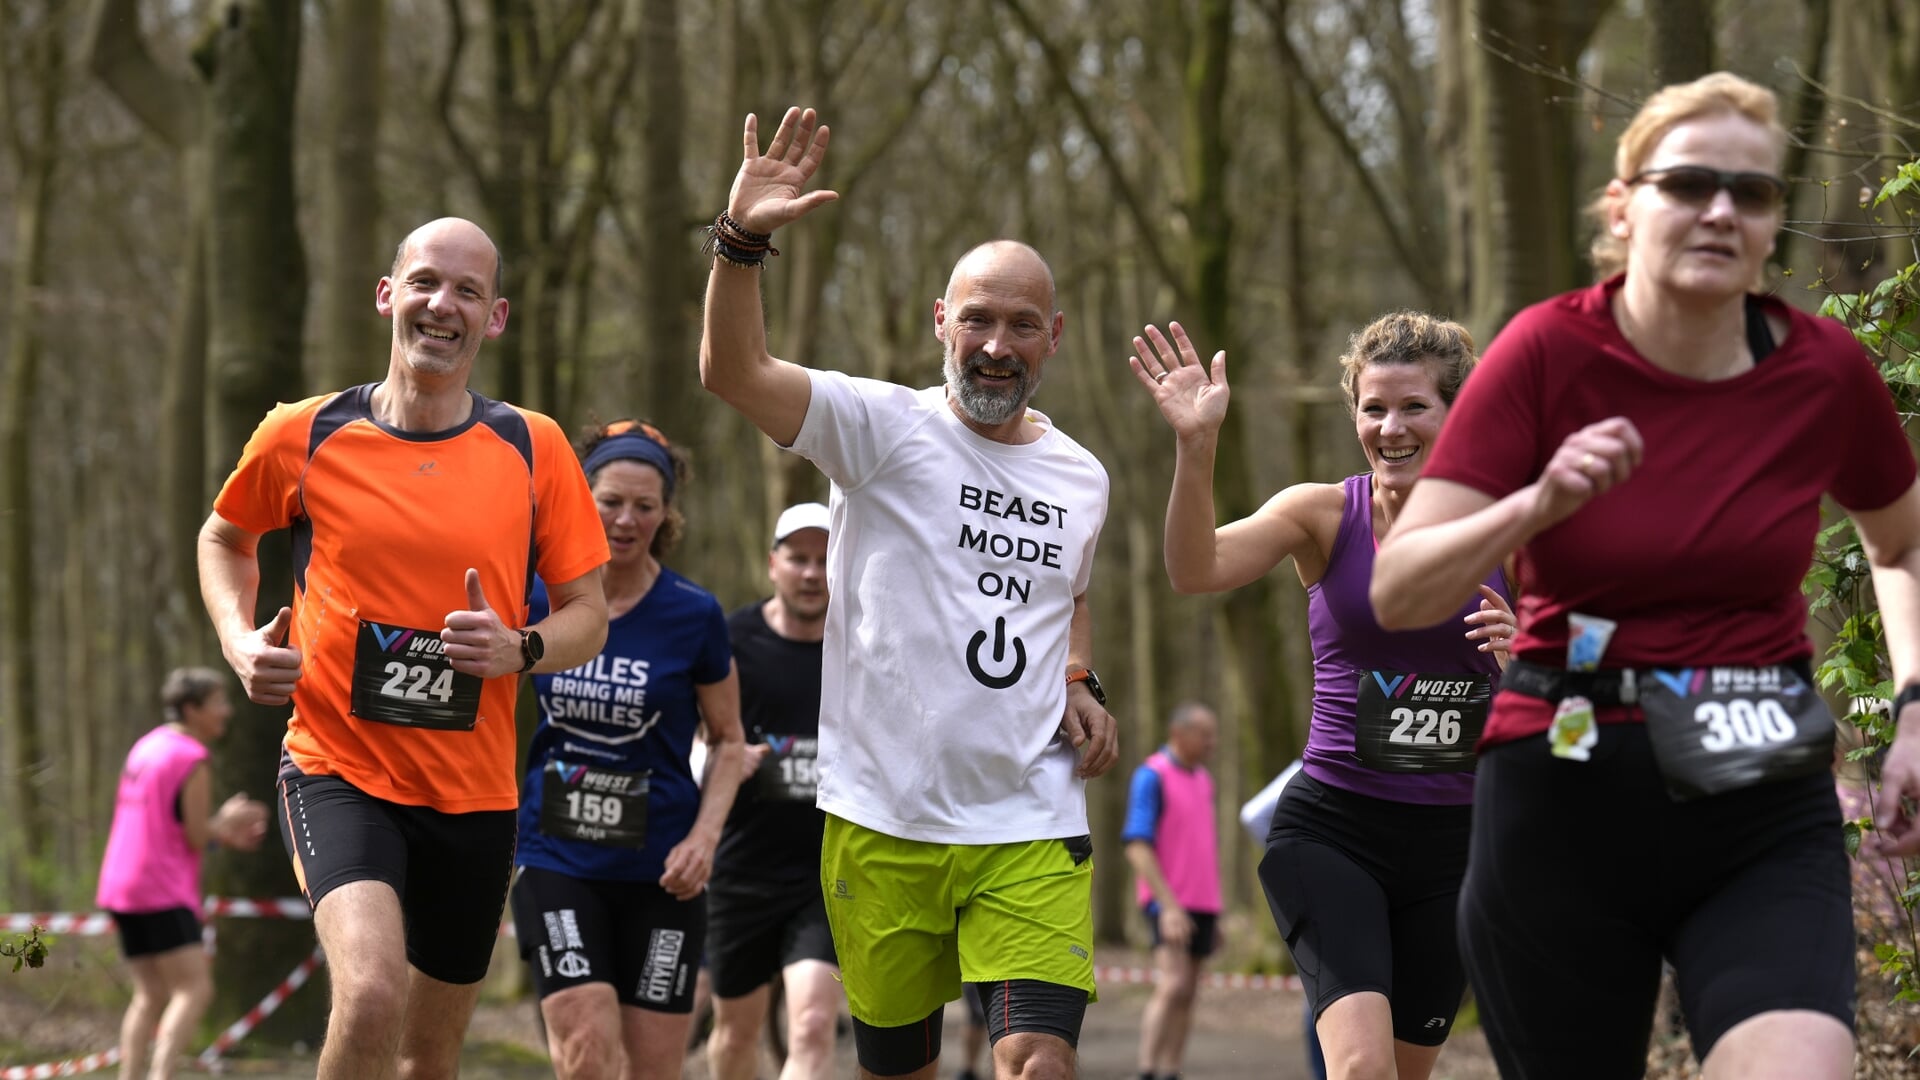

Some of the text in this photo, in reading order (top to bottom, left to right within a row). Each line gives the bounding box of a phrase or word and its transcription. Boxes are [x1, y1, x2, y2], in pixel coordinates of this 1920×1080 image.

[959, 484, 1068, 529] BEAST
[957, 524, 1063, 570] MODE
[977, 572, 1032, 604] ON
[409, 636, 447, 655] WOE
[380, 661, 454, 703] 224
[551, 676, 647, 707] BRING ME
[1413, 679, 1474, 696] WOEST
[550, 696, 643, 728] SMILES
[1389, 707, 1462, 745] 226
[1694, 698, 1798, 752] 300
[582, 770, 632, 789] WOEST
[566, 790, 623, 825] 159
[576, 823, 606, 840] Anja
[646, 929, 684, 1002] CITYLIDO
